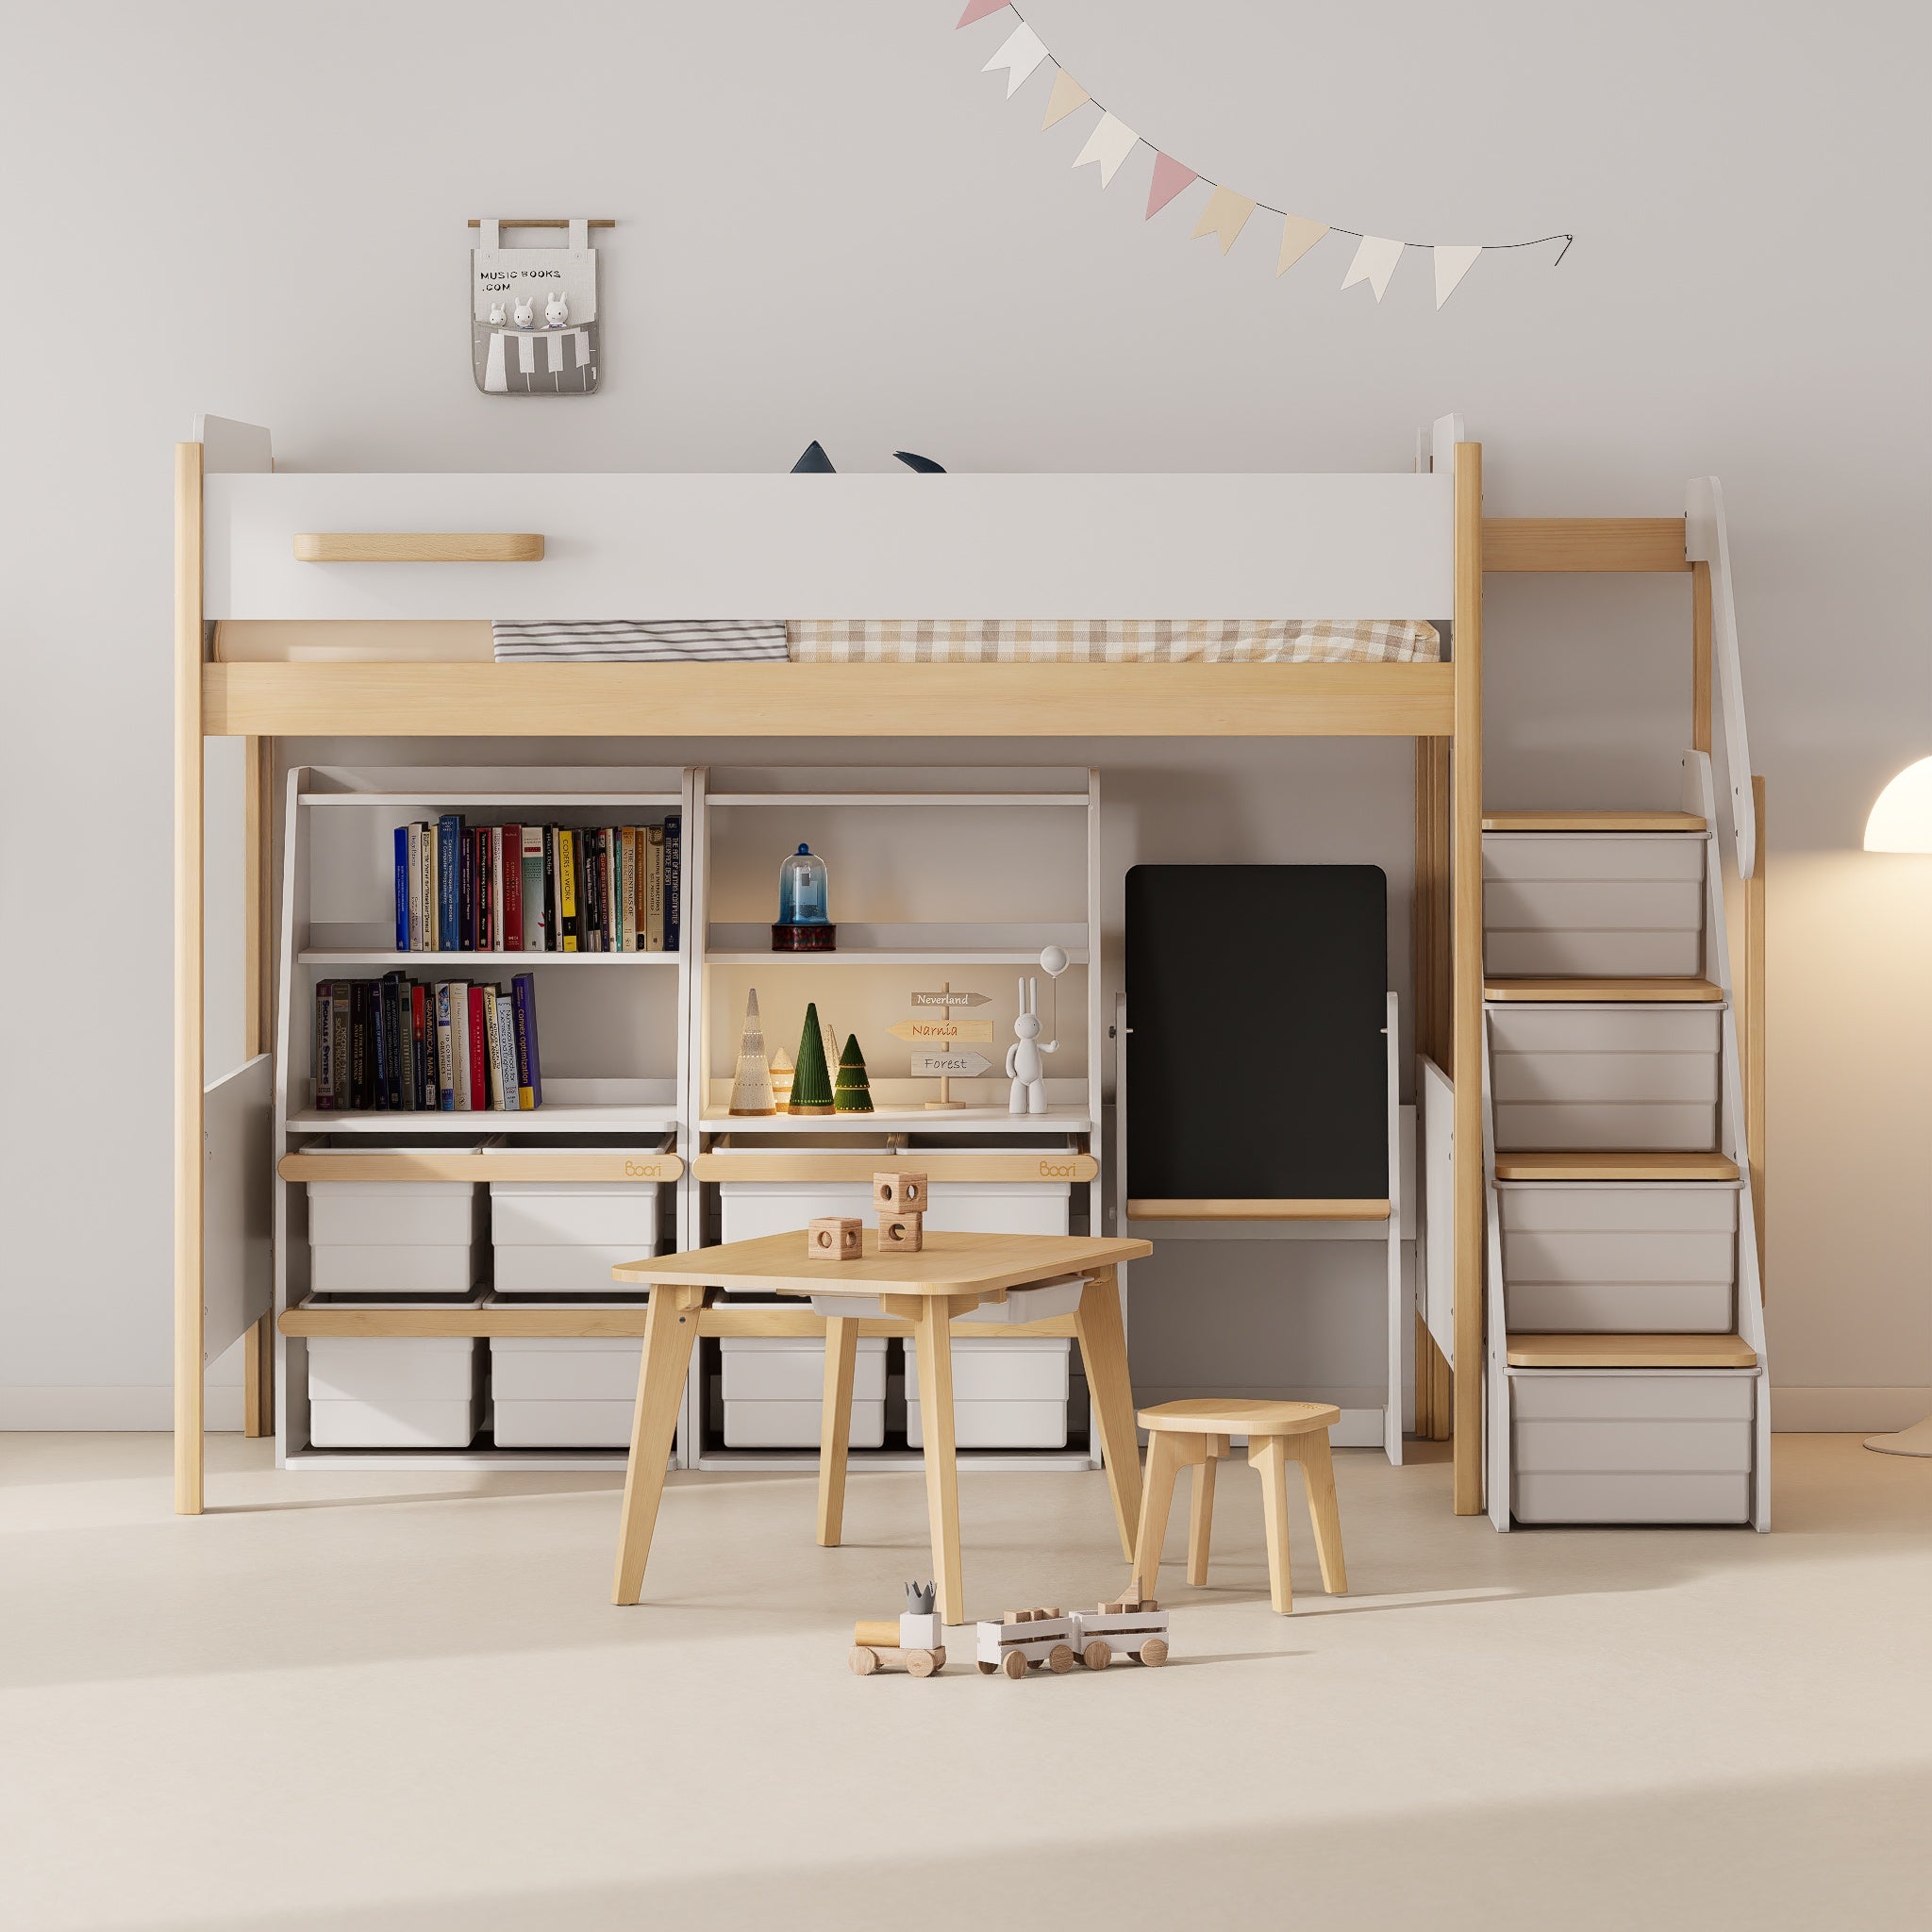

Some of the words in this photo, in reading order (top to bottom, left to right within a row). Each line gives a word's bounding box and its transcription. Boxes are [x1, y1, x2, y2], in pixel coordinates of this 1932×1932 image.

[480, 271, 517, 280] MUSIC
[522, 270, 561, 278] BOOKS
[482, 283, 511, 291] .COM
[917, 993, 969, 1005] Neverland
[322, 1000, 330, 1037] SIGNALS
[425, 999, 434, 1055] GRAMMATICAL
[912, 1023, 958, 1036] Narnia
[924, 1058, 968, 1069] Forest
